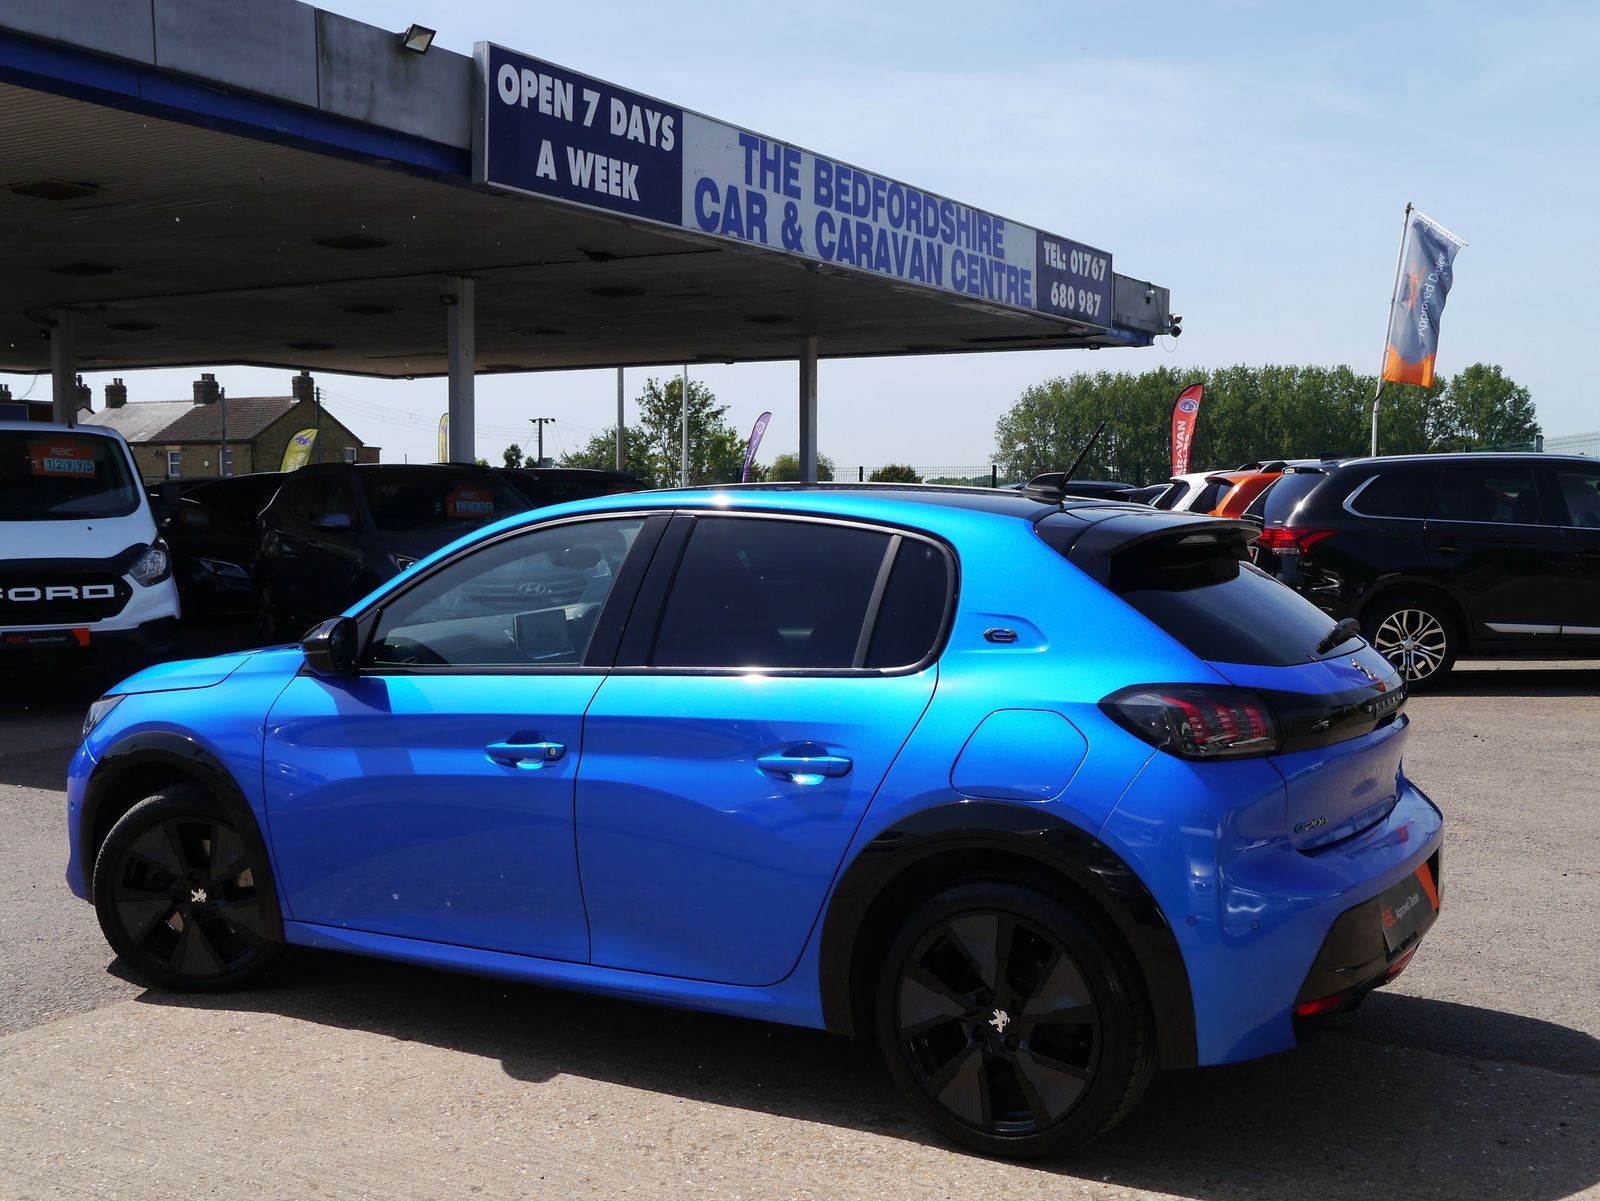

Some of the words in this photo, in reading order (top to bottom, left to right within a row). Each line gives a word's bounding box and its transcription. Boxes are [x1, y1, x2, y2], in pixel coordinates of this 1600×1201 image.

[497, 63, 574, 122] OPEN
[583, 88, 600, 127] 7
[610, 97, 675, 152] DAYS
[535, 139, 557, 181] A
[566, 146, 640, 202] WEEK
[738, 131, 802, 200] THE
[814, 157, 1005, 259] BEDFORDSHIRE
[694, 176, 769, 244] CAR
[781, 201, 804, 253] &
[815, 210, 943, 286] CARAVAN
[951, 248, 1032, 308] CENTRE
[1043, 240, 1067, 271] TEL:
[1070, 249, 1107, 281] 01767
[1050, 281, 1076, 310] 680
[1078, 289, 1102, 316] 987
[1418, 283, 1435, 337] Approved
[1176, 421, 1186, 476] ARAVAN
[0, 584, 115, 601] ORD
